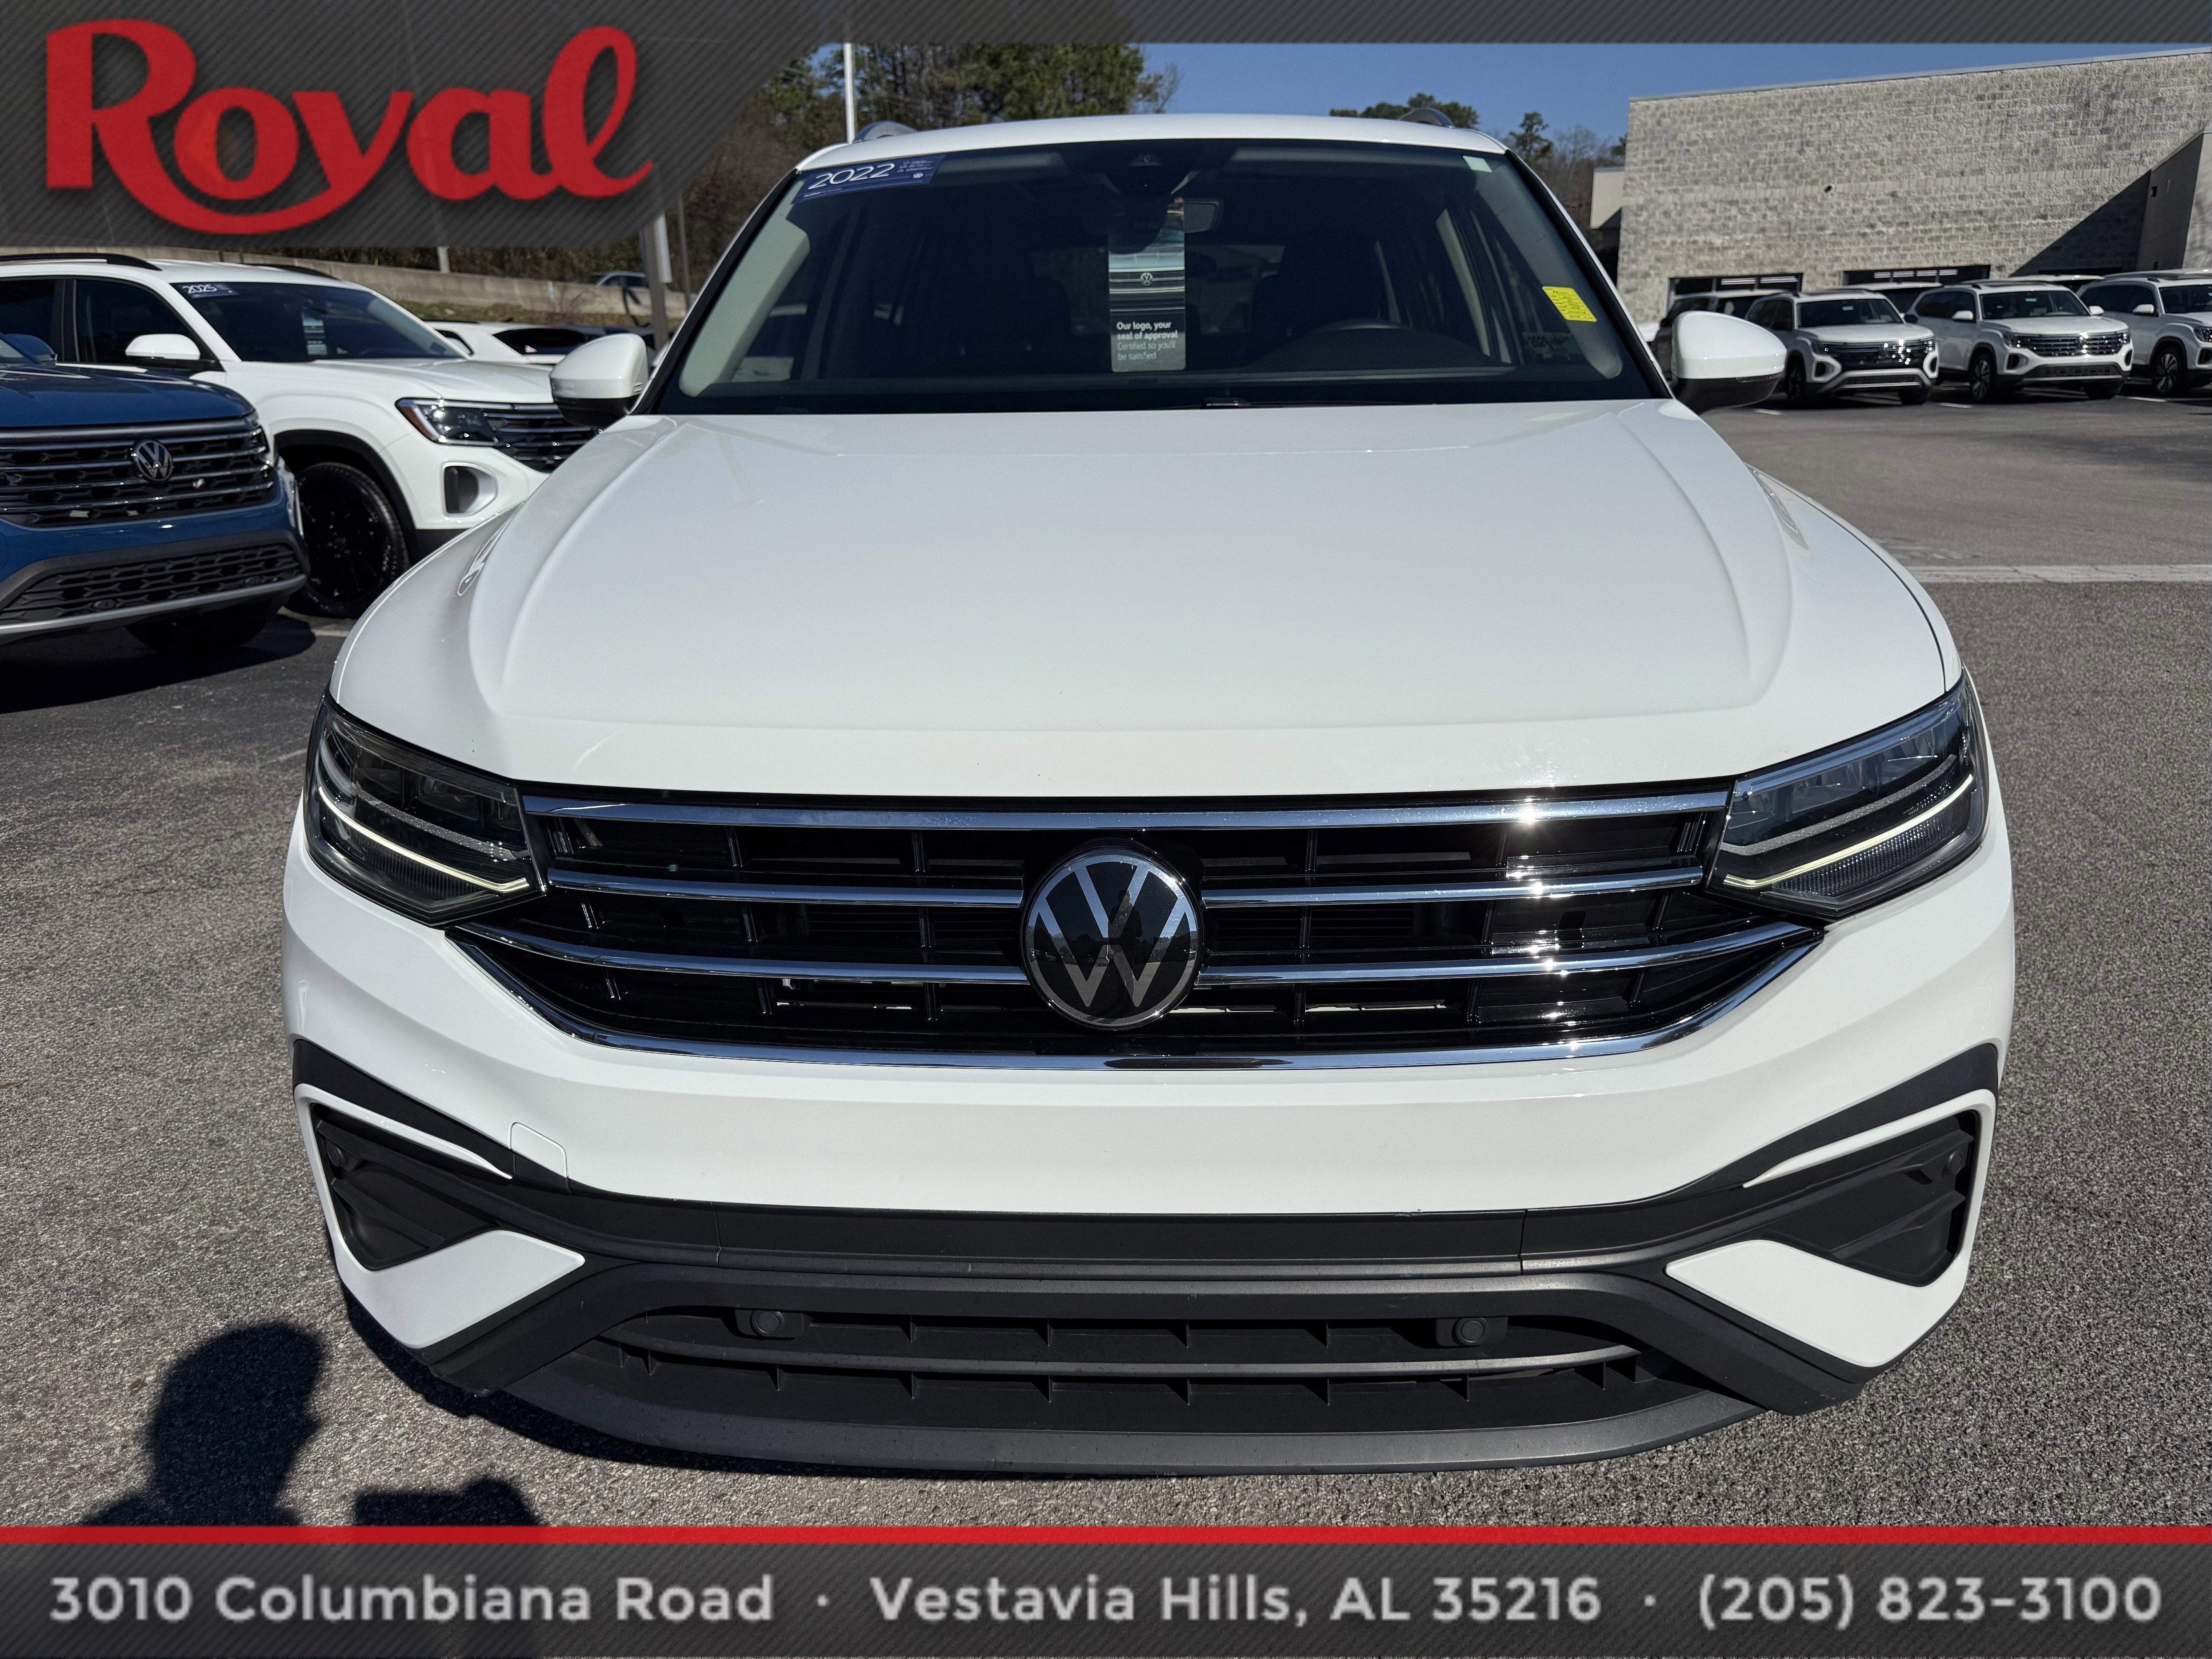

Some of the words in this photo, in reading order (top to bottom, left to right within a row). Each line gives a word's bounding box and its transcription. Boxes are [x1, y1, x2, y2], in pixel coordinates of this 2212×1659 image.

[808, 163, 895, 190] 2022
[182, 283, 218, 294] 2025
[1116, 321, 1131, 330] Our
[1133, 320, 1152, 331] logo,
[1154, 321, 1172, 331] your
[1117, 331, 1133, 340] seal
[1134, 331, 1143, 340] of
[1144, 329, 1178, 341] approval
